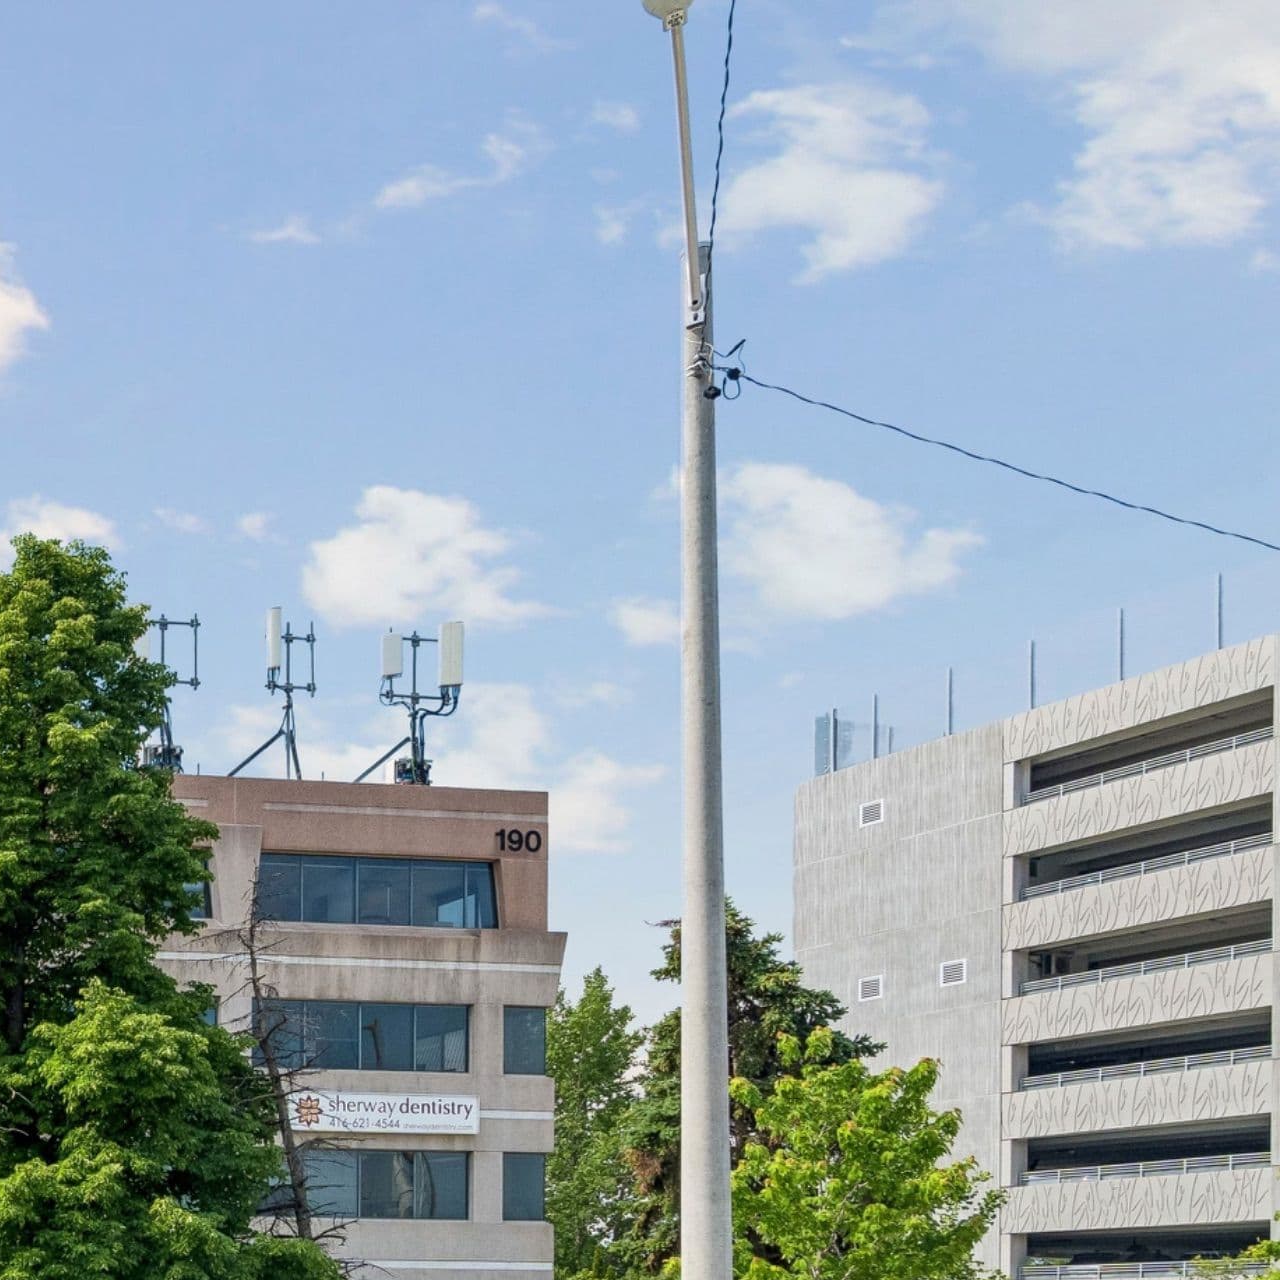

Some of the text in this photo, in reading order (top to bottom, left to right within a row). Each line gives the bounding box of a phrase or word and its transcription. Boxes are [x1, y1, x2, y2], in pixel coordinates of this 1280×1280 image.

[495, 828, 542, 853] 190
[329, 1095, 473, 1120] sherway dentistry
[329, 1118, 400, 1129] 416-621-4544
